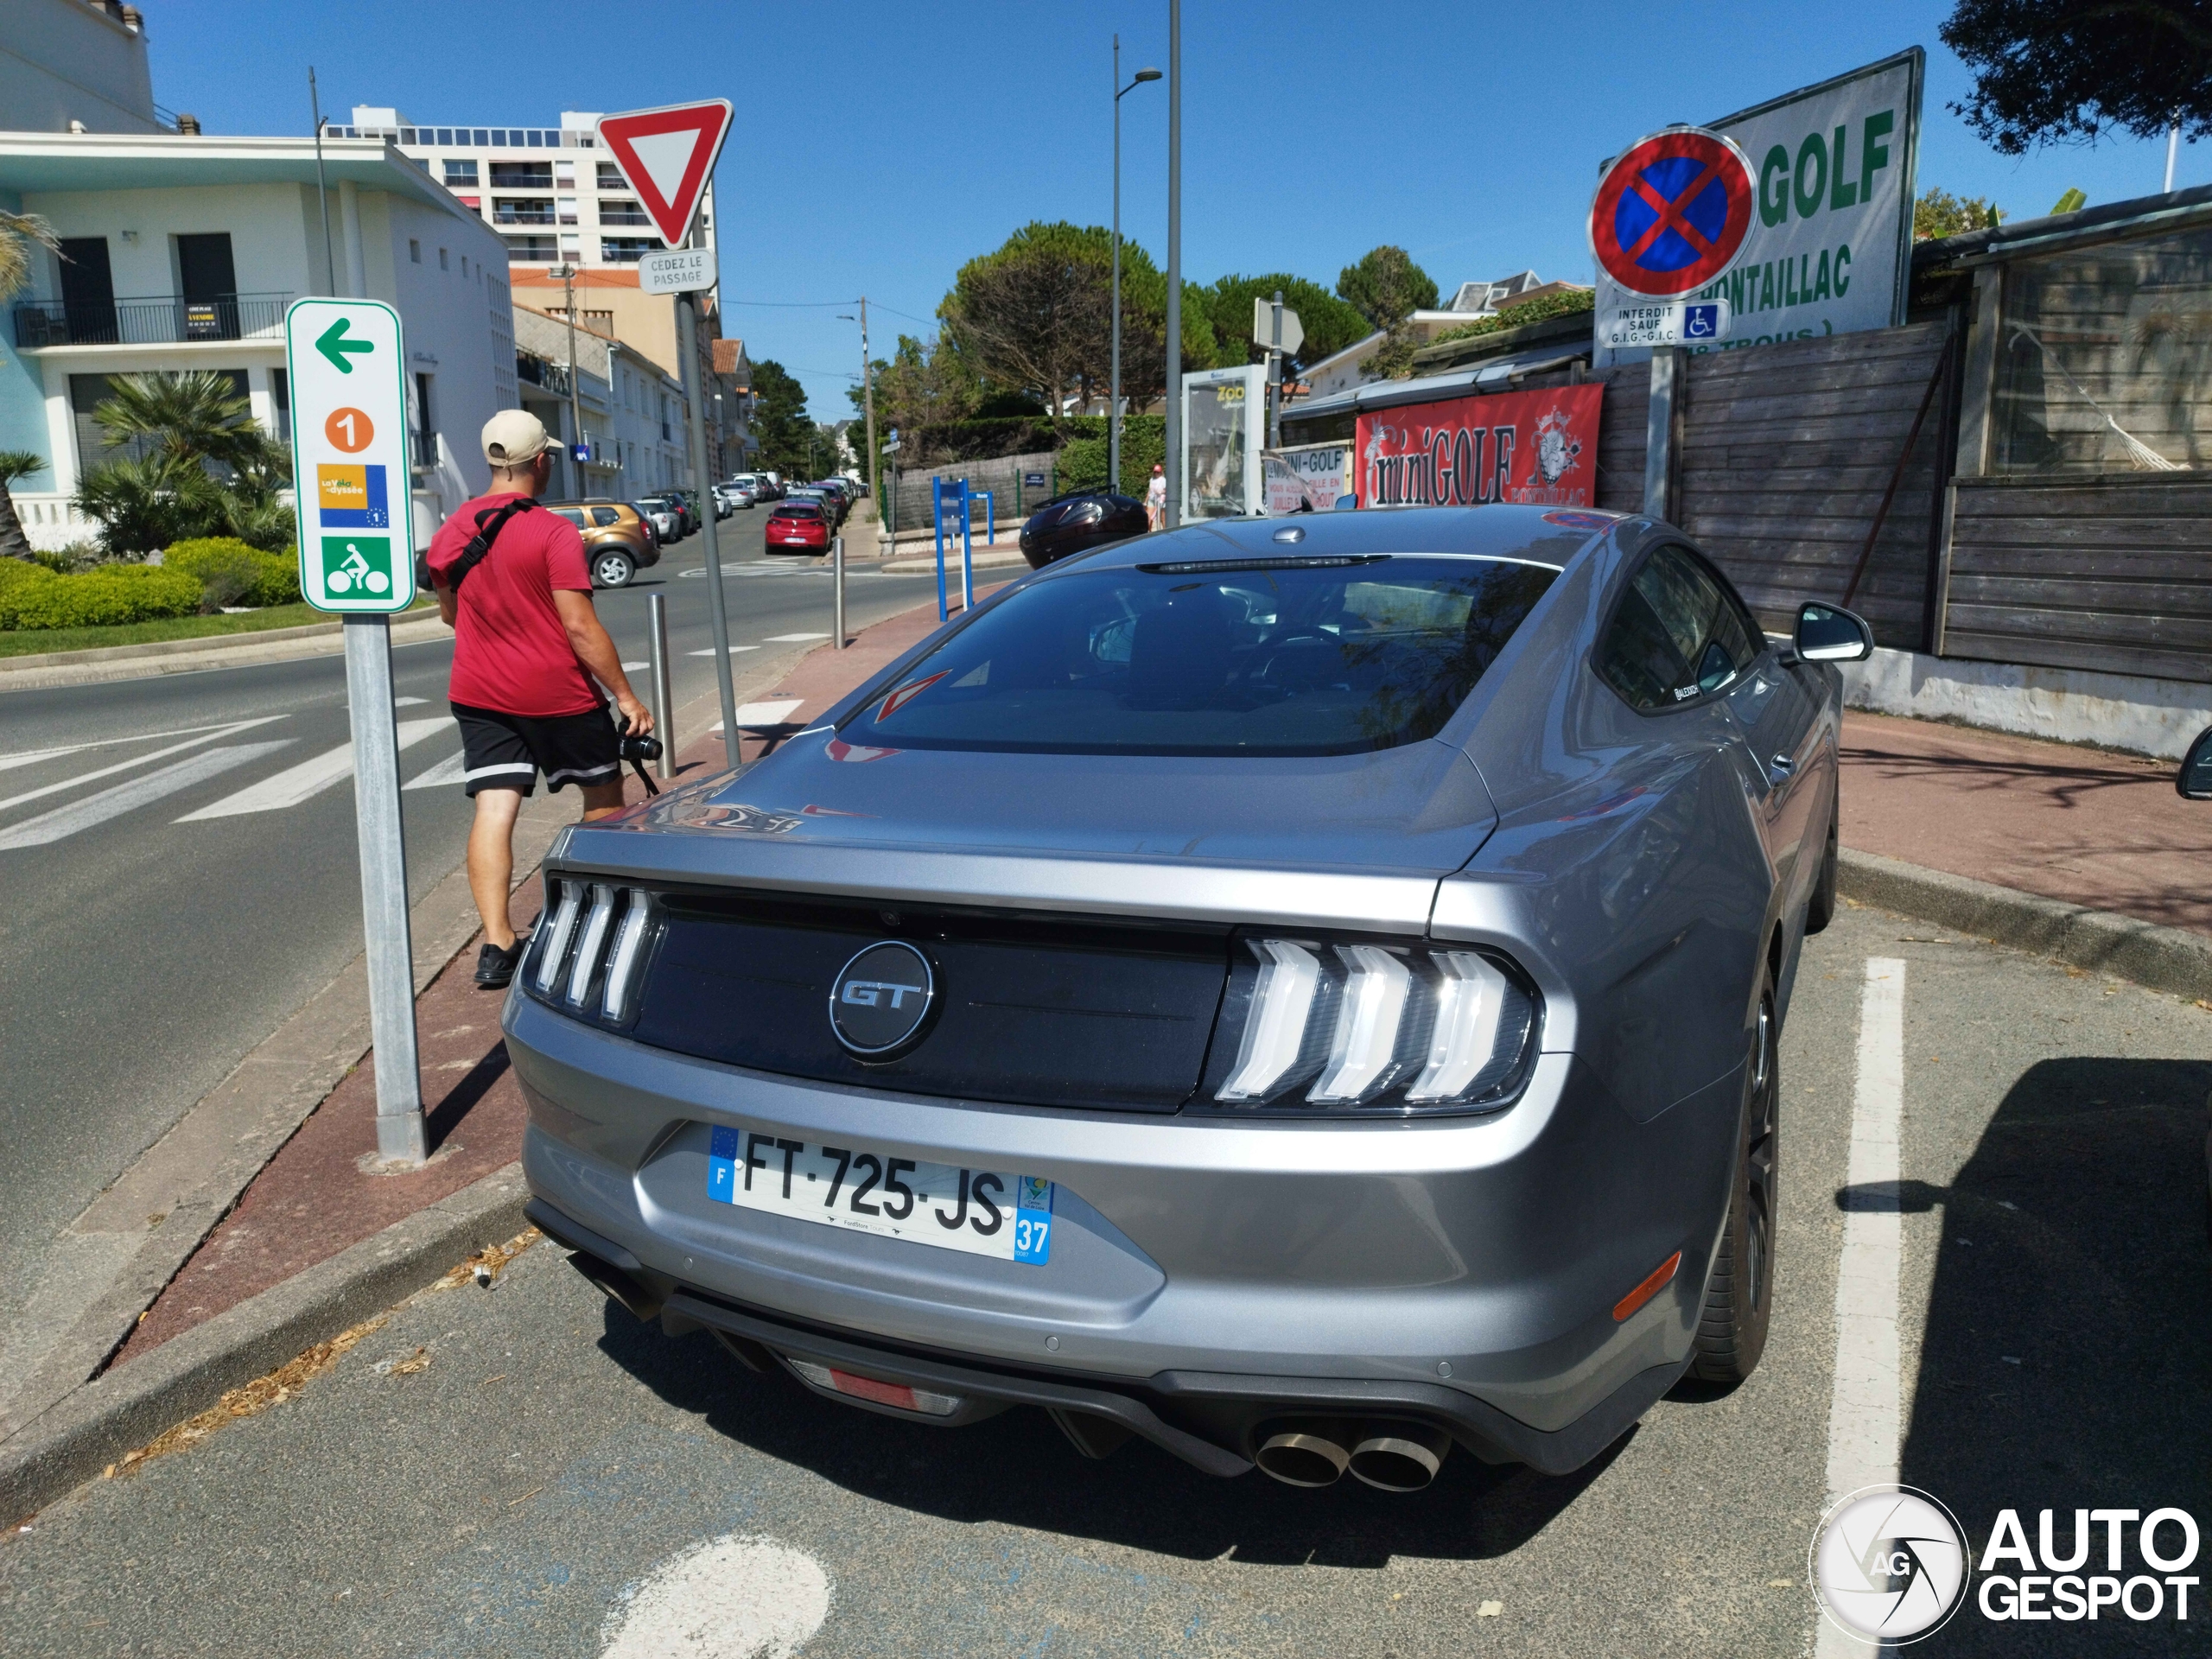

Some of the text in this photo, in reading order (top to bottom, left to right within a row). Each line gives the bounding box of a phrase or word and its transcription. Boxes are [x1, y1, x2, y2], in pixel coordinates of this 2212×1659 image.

[1759, 109, 1894, 228] GOLF
[652, 256, 702, 271] CÉDEZ LE
[653, 270, 702, 286] PASSAGE
[1618, 307, 1673, 320] INTERDIT
[1630, 320, 1661, 331] SAUF
[336, 414, 355, 447] 1
[1376, 425, 1516, 505] miniGOLF
[1330, 478, 1339, 487] EN
[373, 512, 378, 522] 1
[842, 980, 922, 1009] GT
[716, 1133, 1005, 1236] F FT-725-JS
[843, 1219, 885, 1233] FordStore Tours
[1017, 1219, 1048, 1253] 37
